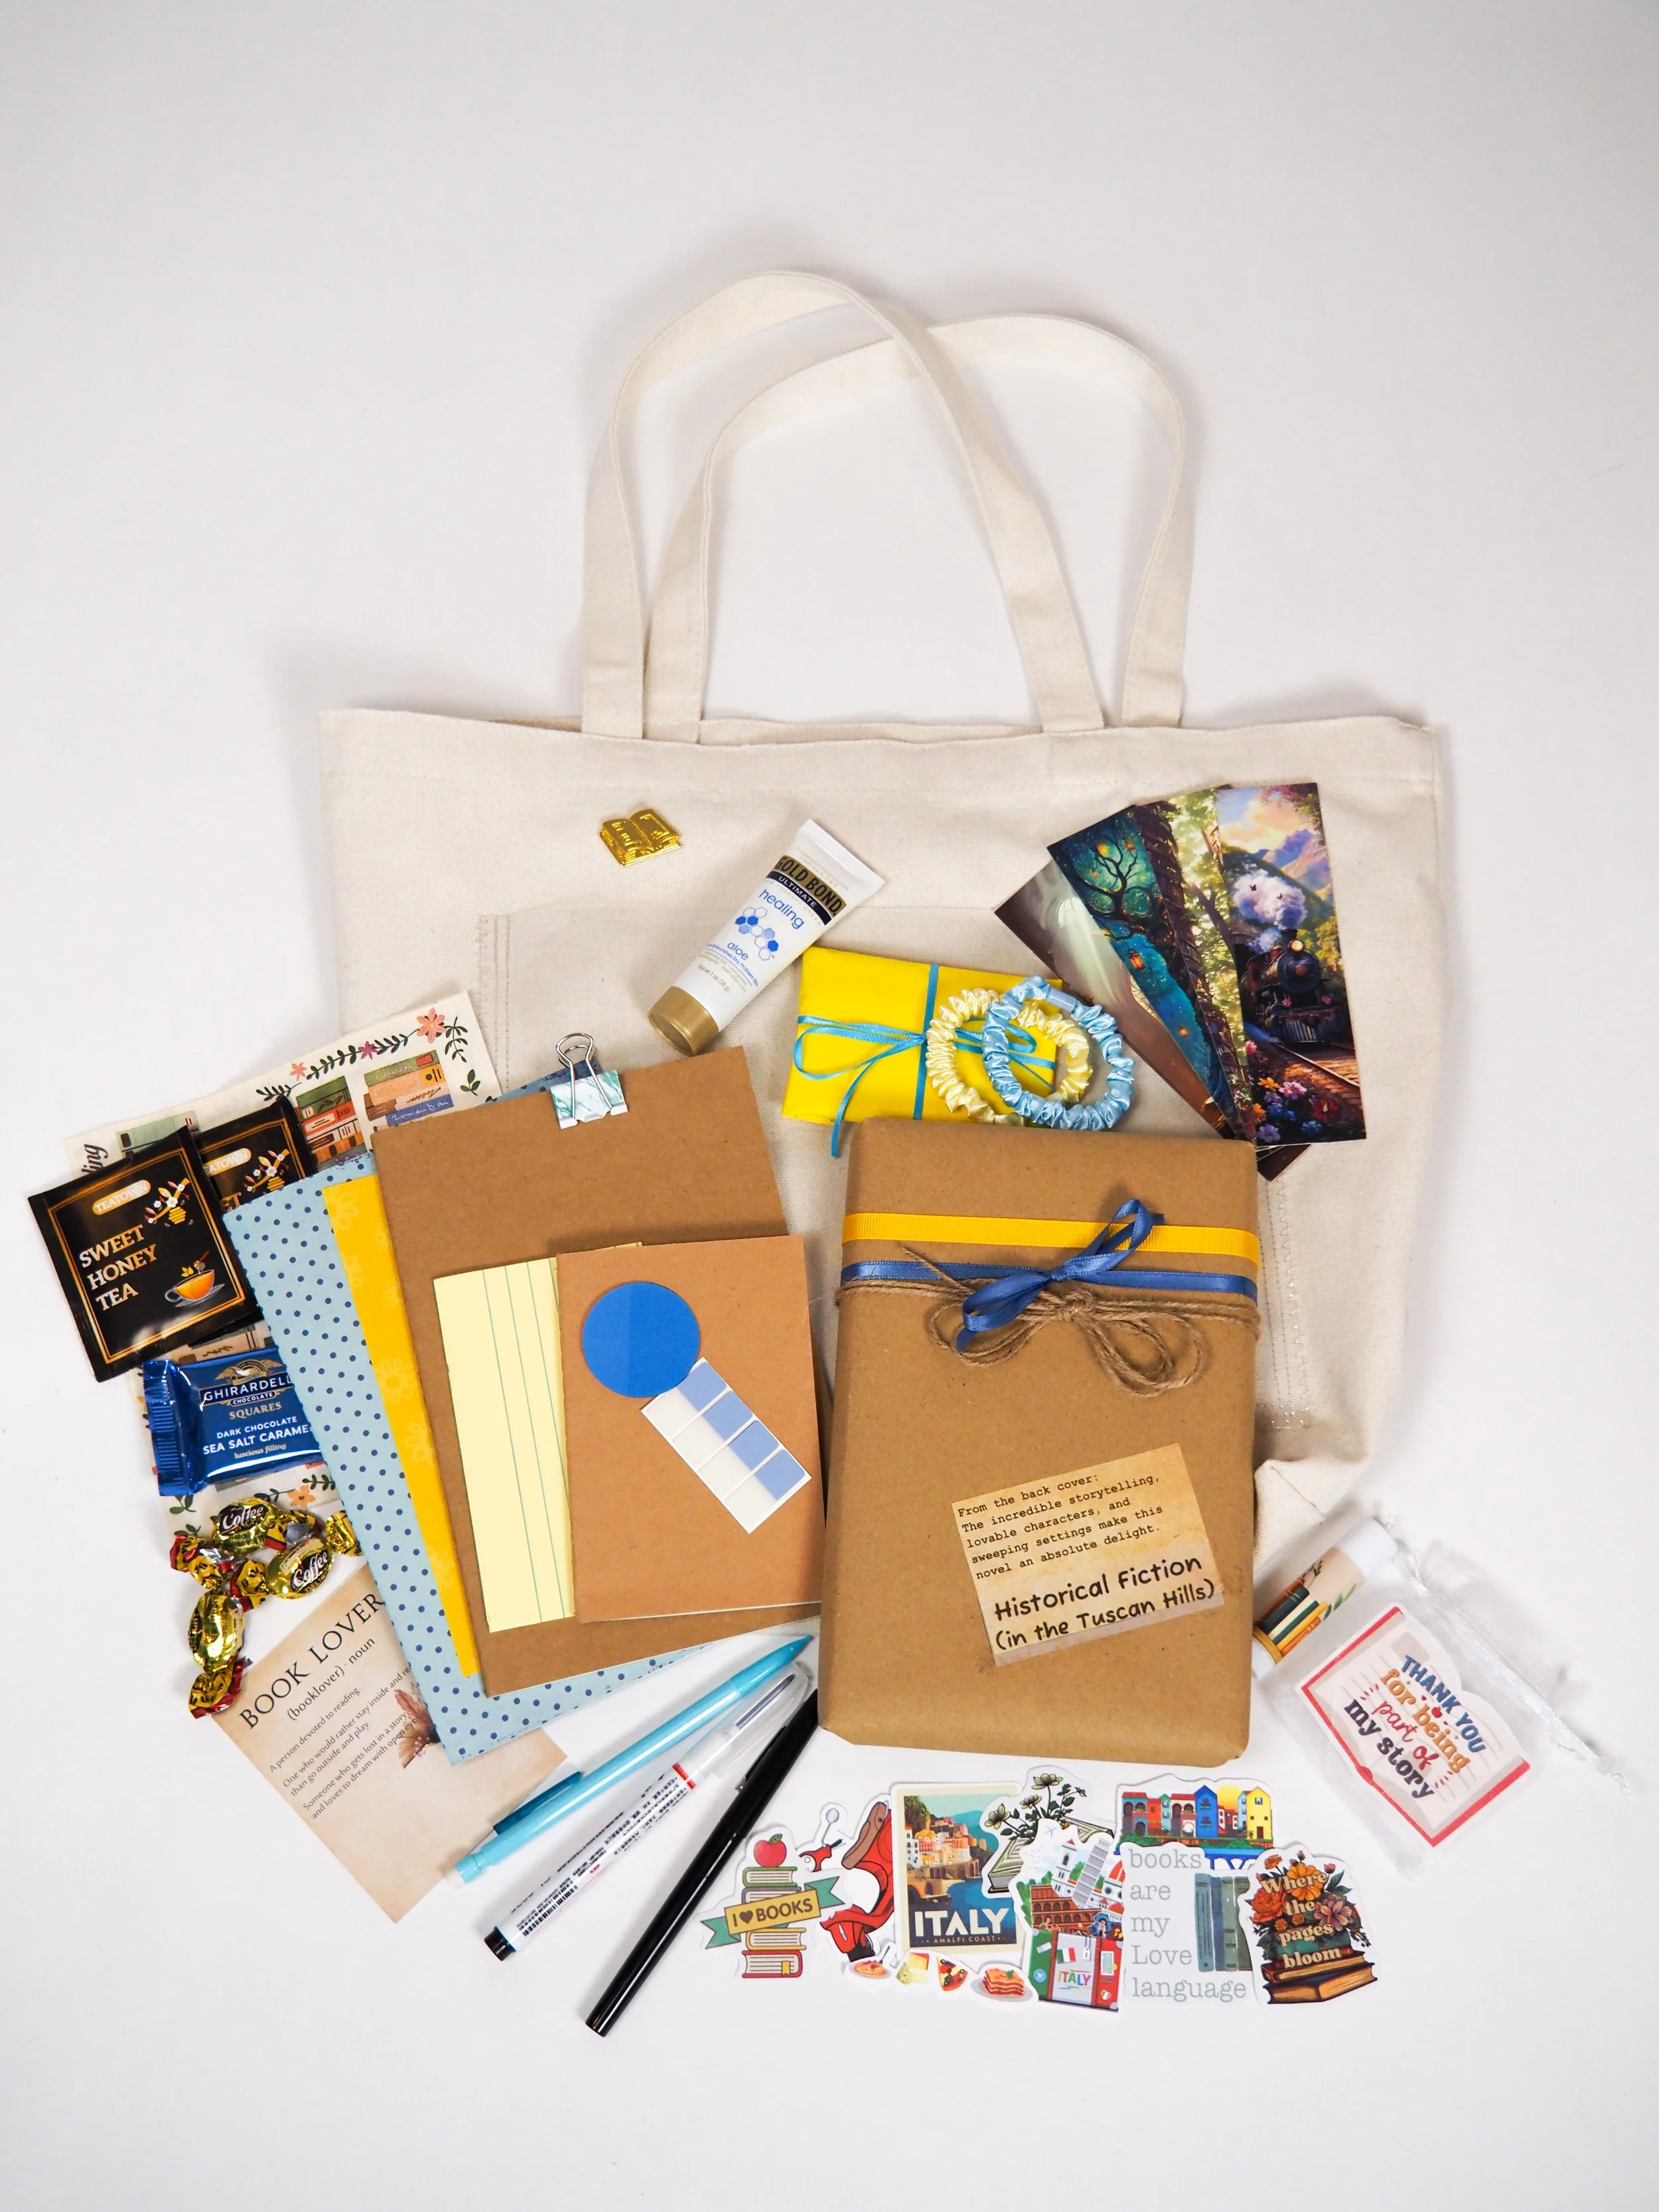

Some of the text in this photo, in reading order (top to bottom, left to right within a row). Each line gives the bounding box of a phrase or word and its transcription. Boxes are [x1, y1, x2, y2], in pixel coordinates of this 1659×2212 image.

[774, 857, 808, 882] GOLD
[804, 877, 842, 913] BOND
[778, 876, 817, 908] ULTIMATE
[759, 889, 804, 929] healing
[727, 942, 749, 960] aloe
[95, 1183, 149, 1213] TEATOWN
[79, 1224, 145, 1268] SWEET
[87, 1244, 157, 1290] HONEY
[96, 1282, 139, 1311] TEA
[229, 1402, 282, 1420] SQUARES
[232, 1392, 273, 1405] CHOCOLATE
[203, 1424, 309, 1455] SEA SALT CARAME
[216, 1416, 298, 1439] DARK CHOCOLATE
[234, 1442, 287, 1459] luscious filling
[958, 1475, 1098, 1517] From the back cover:
[962, 1476, 1159, 1532] The incredible storytelling,
[223, 1507, 264, 1530] Coffee
[966, 1497, 1131, 1548] lovable characters, and
[972, 1507, 1163, 1564] sweeping settings make this
[293, 1552, 328, 1587] Coffee
[976, 1525, 1159, 1580] novel an absolute delight.
[995, 1558, 1202, 1621] Historical Fiction
[995, 1578, 1214, 1650] (in the Tuscan Hills)
[239, 1593, 386, 1730] BOOK LOVER
[287, 1639, 375, 1721] (booklover) noun
[1380, 1668, 1471, 1773] for being
[1401, 1655, 1486, 1753] THANK YOU
[276, 1744, 300, 1769] person
[299, 1717, 326, 1745] devoted
[333, 1688, 360, 1712] reading.
[283, 1773, 299, 1787] One
[299, 1758, 315, 1773] who
[313, 1735, 336, 1758] would
[336, 1719, 356, 1739] rather
[356, 1706, 370, 1720] stay
[369, 1687, 390, 1707] inside
[390, 1672, 403, 1688] and
[1371, 1701, 1439, 1771] part of
[291, 1722, 370, 1796] than go outside and play.
[1344, 1699, 1435, 1798] my story
[303, 1780, 336, 1810] Someone
[334, 1765, 350, 1781] who
[350, 1753, 365, 1769] gets
[362, 1740, 378, 1753] lost
[313, 1803, 325, 1819] and
[323, 1789, 343, 1806] loves
[350, 1761, 373, 1781] dream
[372, 1746, 388, 1761] with
[388, 1730, 409, 1747] open
[1128, 1848, 1202, 1869] books
[1130, 1884, 1171, 1900] are
[1260, 1872, 1328, 1894] Where
[732, 1897, 813, 1927] I BOOKS
[914, 1908, 1009, 1937] ITALY
[1285, 1899, 1316, 1915] the
[1130, 1917, 1171, 1938] my
[1278, 1924, 1334, 1947] pages
[1131, 1945, 1192, 1965] Love
[1281, 1947, 1342, 1968] bloom
[1058, 1970, 1091, 1986] ITALY
[1132, 1978, 1246, 2002] language
